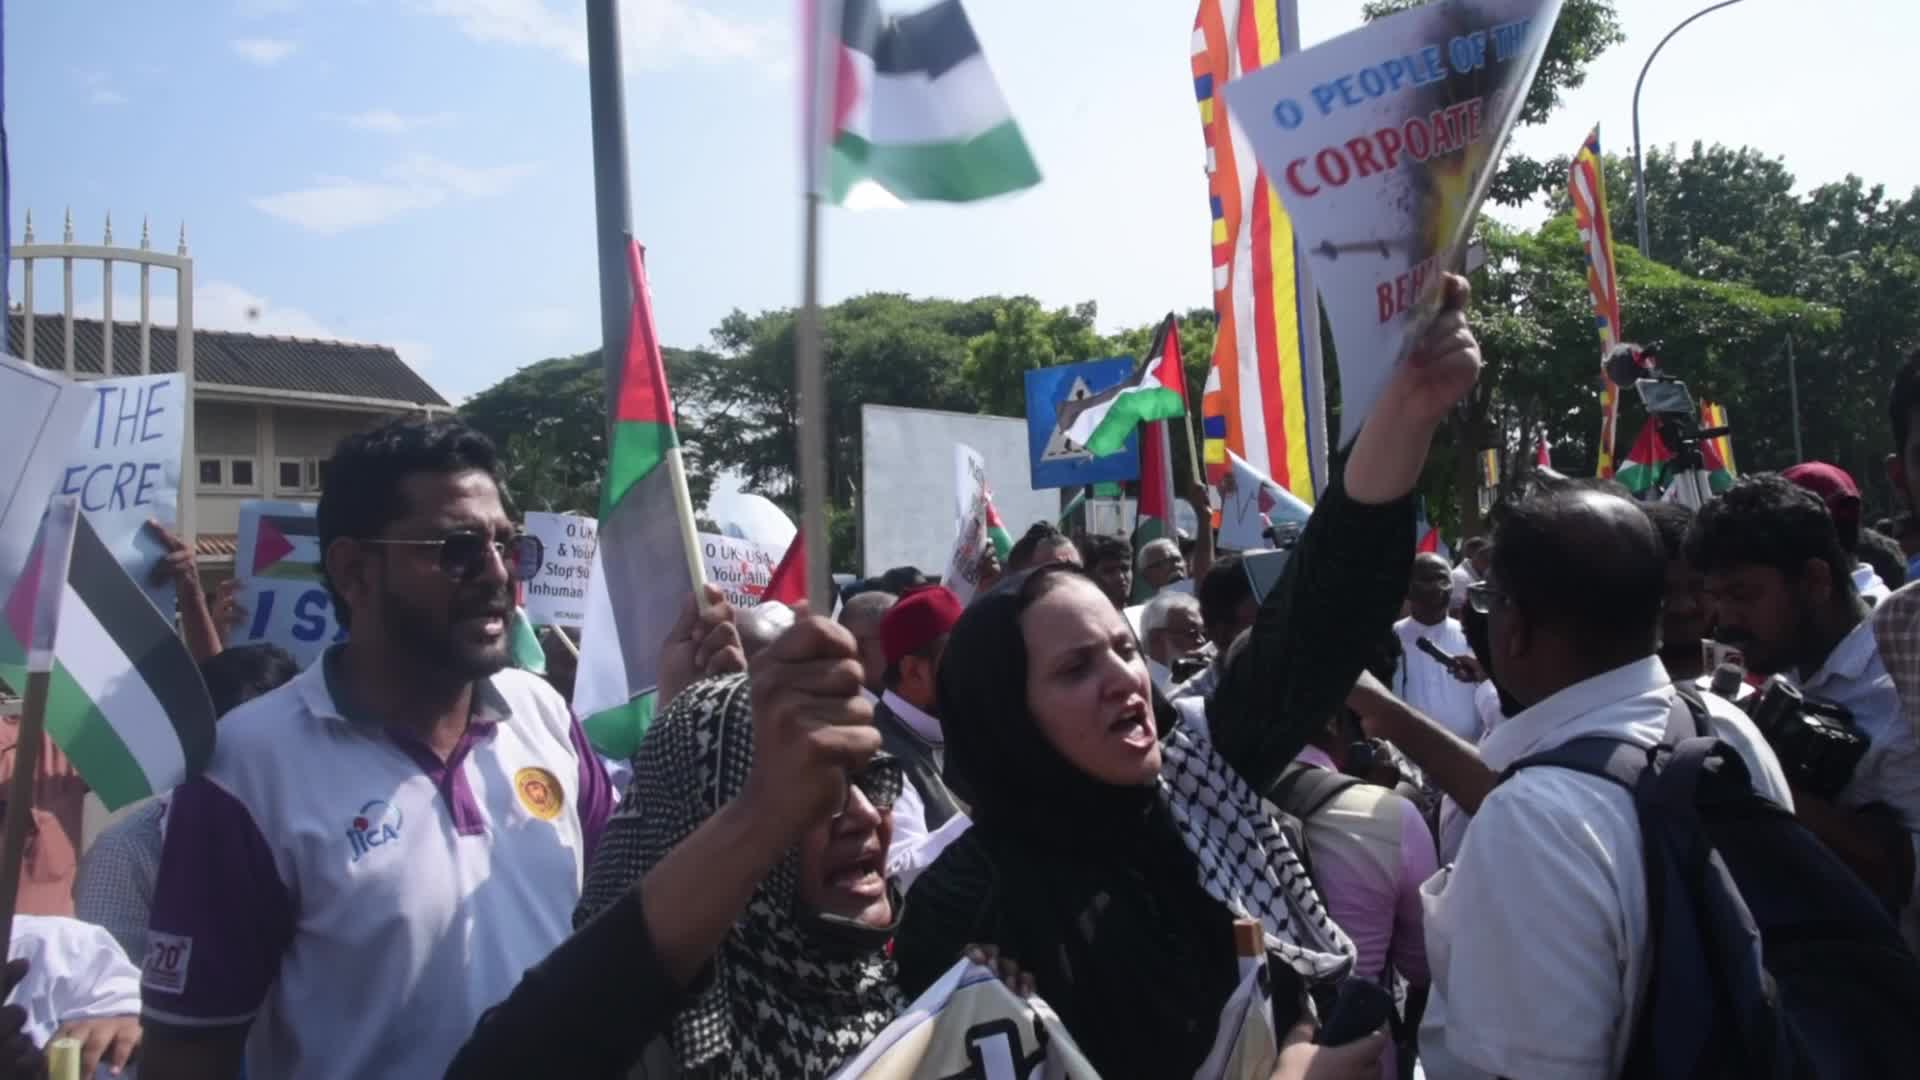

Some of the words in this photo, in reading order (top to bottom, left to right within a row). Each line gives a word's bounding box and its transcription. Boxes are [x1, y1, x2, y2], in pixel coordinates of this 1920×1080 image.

[1273, 98, 1304, 130] O
[1311, 46, 1446, 116] PEOPLE
[1449, 31, 1486, 74] OF
[1285, 97, 1483, 198] CORPOATE
[94, 380, 171, 449] THE
[545, 561, 573, 580] Stop
[557, 542, 567, 557] &
[712, 565, 741, 583] Your
